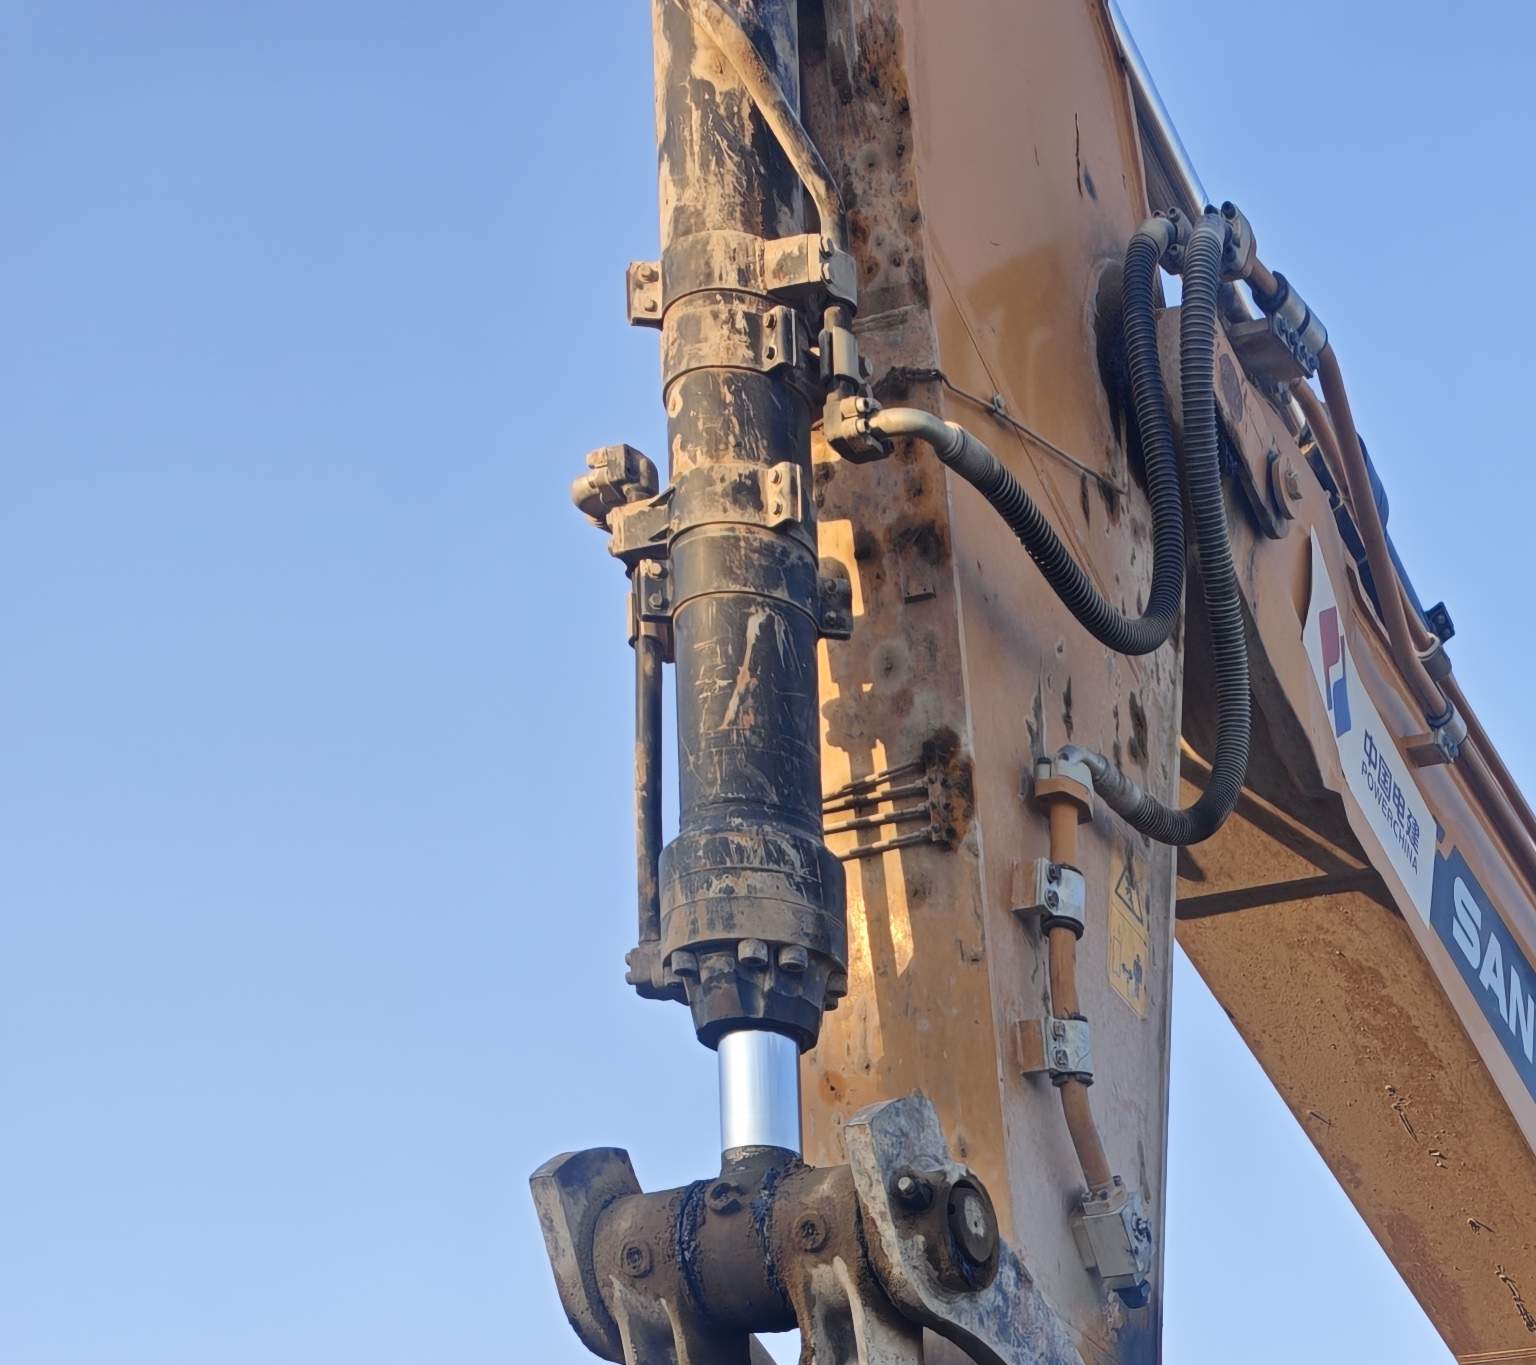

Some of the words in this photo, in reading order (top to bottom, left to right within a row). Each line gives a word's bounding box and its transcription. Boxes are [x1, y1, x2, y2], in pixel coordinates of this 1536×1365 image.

[1361, 761, 1418, 875] POWERCHINA
[1363, 728, 1420, 855] 中国电建
